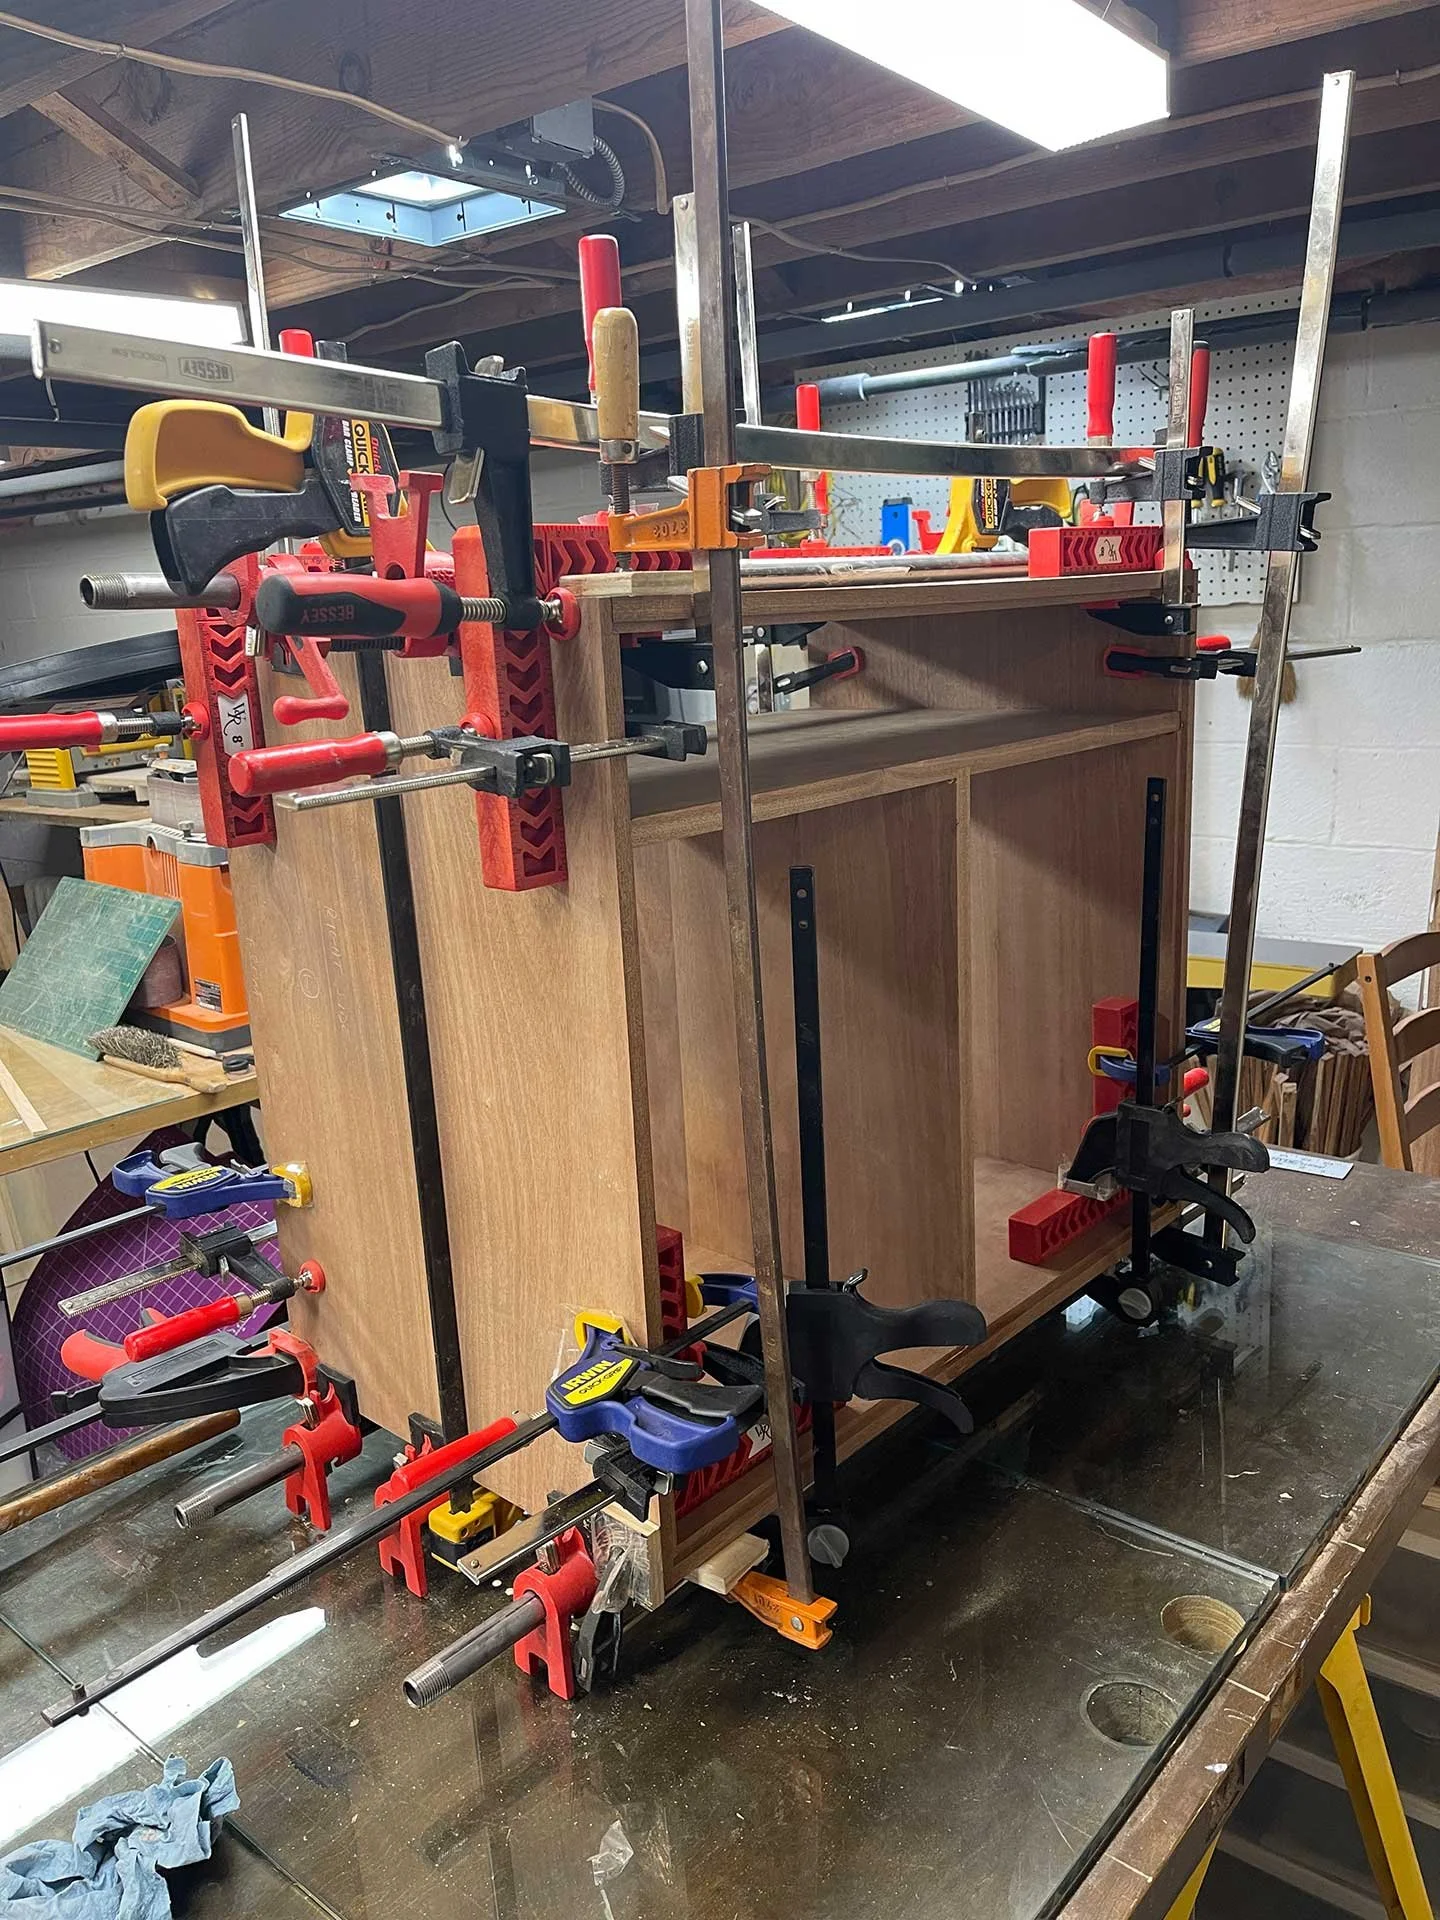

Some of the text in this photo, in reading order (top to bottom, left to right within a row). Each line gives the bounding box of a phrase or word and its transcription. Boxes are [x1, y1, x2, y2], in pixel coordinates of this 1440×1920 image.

[183, 359, 229, 379] BESSEY
[342, 420, 351, 438] BAR
[344, 439, 354, 468] CLAMP
[371, 436, 382, 473] Quick
[300, 604, 355, 624] BESSEY
[175, 1172, 221, 1189] IRWIN
[560, 1360, 613, 1391] IRWIN
